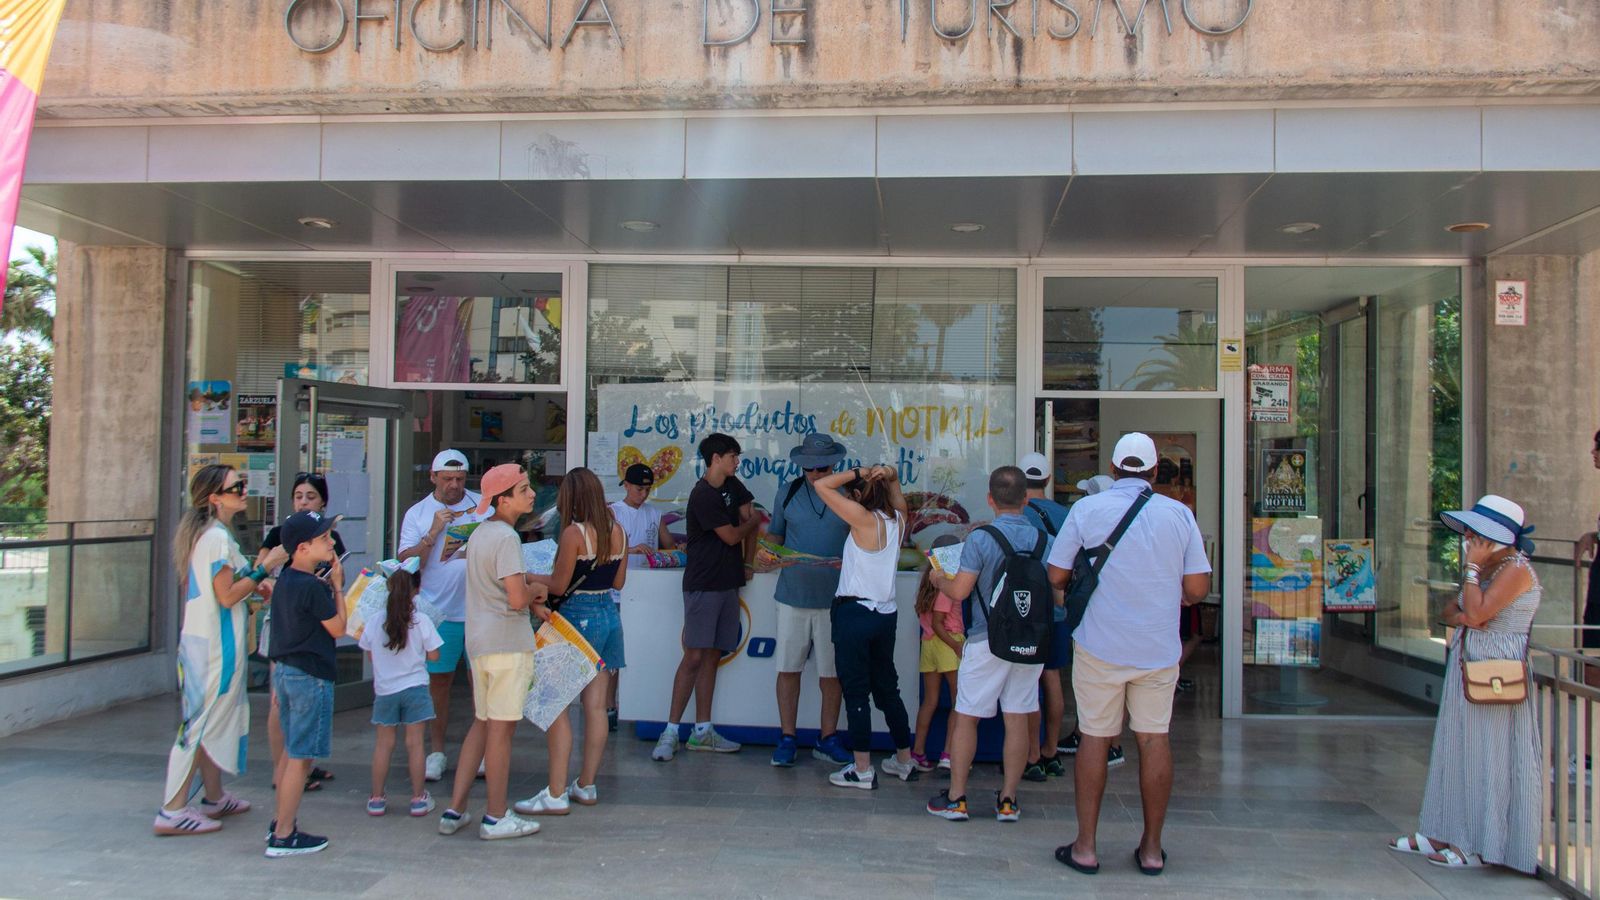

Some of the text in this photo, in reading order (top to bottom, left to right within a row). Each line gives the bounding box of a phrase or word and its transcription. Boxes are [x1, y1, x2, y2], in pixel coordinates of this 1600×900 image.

[285, 0, 625, 52] OFICINA
[703, 0, 807, 46] DE
[240, 397, 276, 405] ZARZUELA
[1270, 398, 1288, 407] 24h
[624, 404, 679, 439] Los
[690, 400, 817, 444] productos
[829, 409, 857, 436] de
[1265, 498, 1305, 506] MOTRIL
[1010, 646, 1036, 654] capelli
